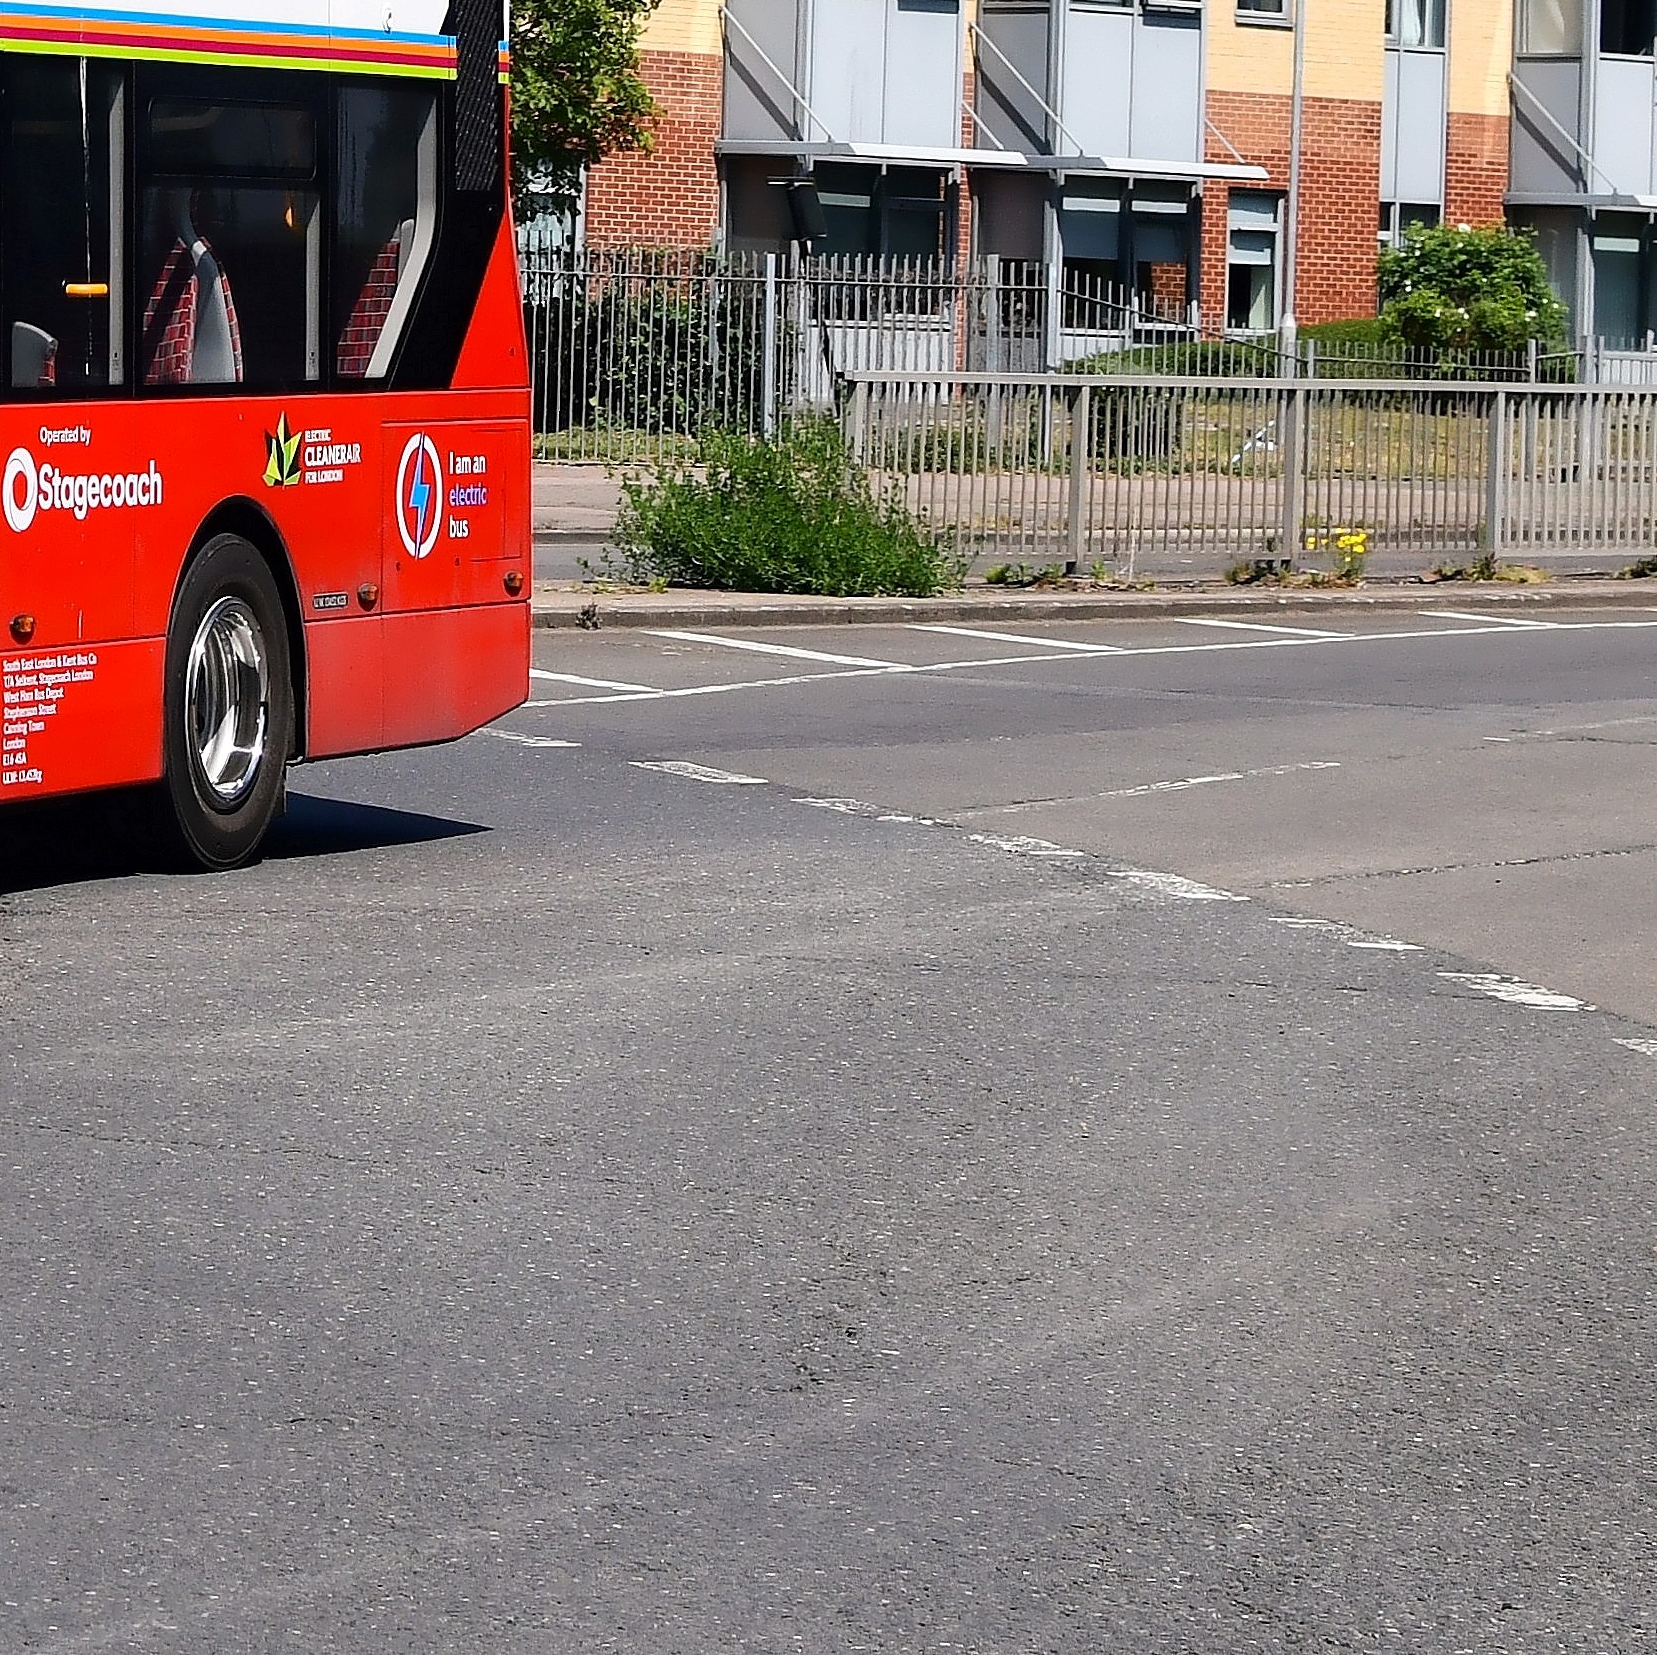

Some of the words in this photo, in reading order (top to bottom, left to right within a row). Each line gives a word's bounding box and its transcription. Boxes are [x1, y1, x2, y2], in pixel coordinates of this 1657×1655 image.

[39, 426, 79, 447] Operated
[80, 425, 91, 446] by
[305, 429, 332, 443] ELECTRIC
[449, 452, 454, 474] I
[455, 457, 471, 474] am
[472, 455, 486, 473] an
[38, 459, 162, 520] Stagecoach
[449, 483, 487, 506] electric
[449, 514, 469, 538] bus
